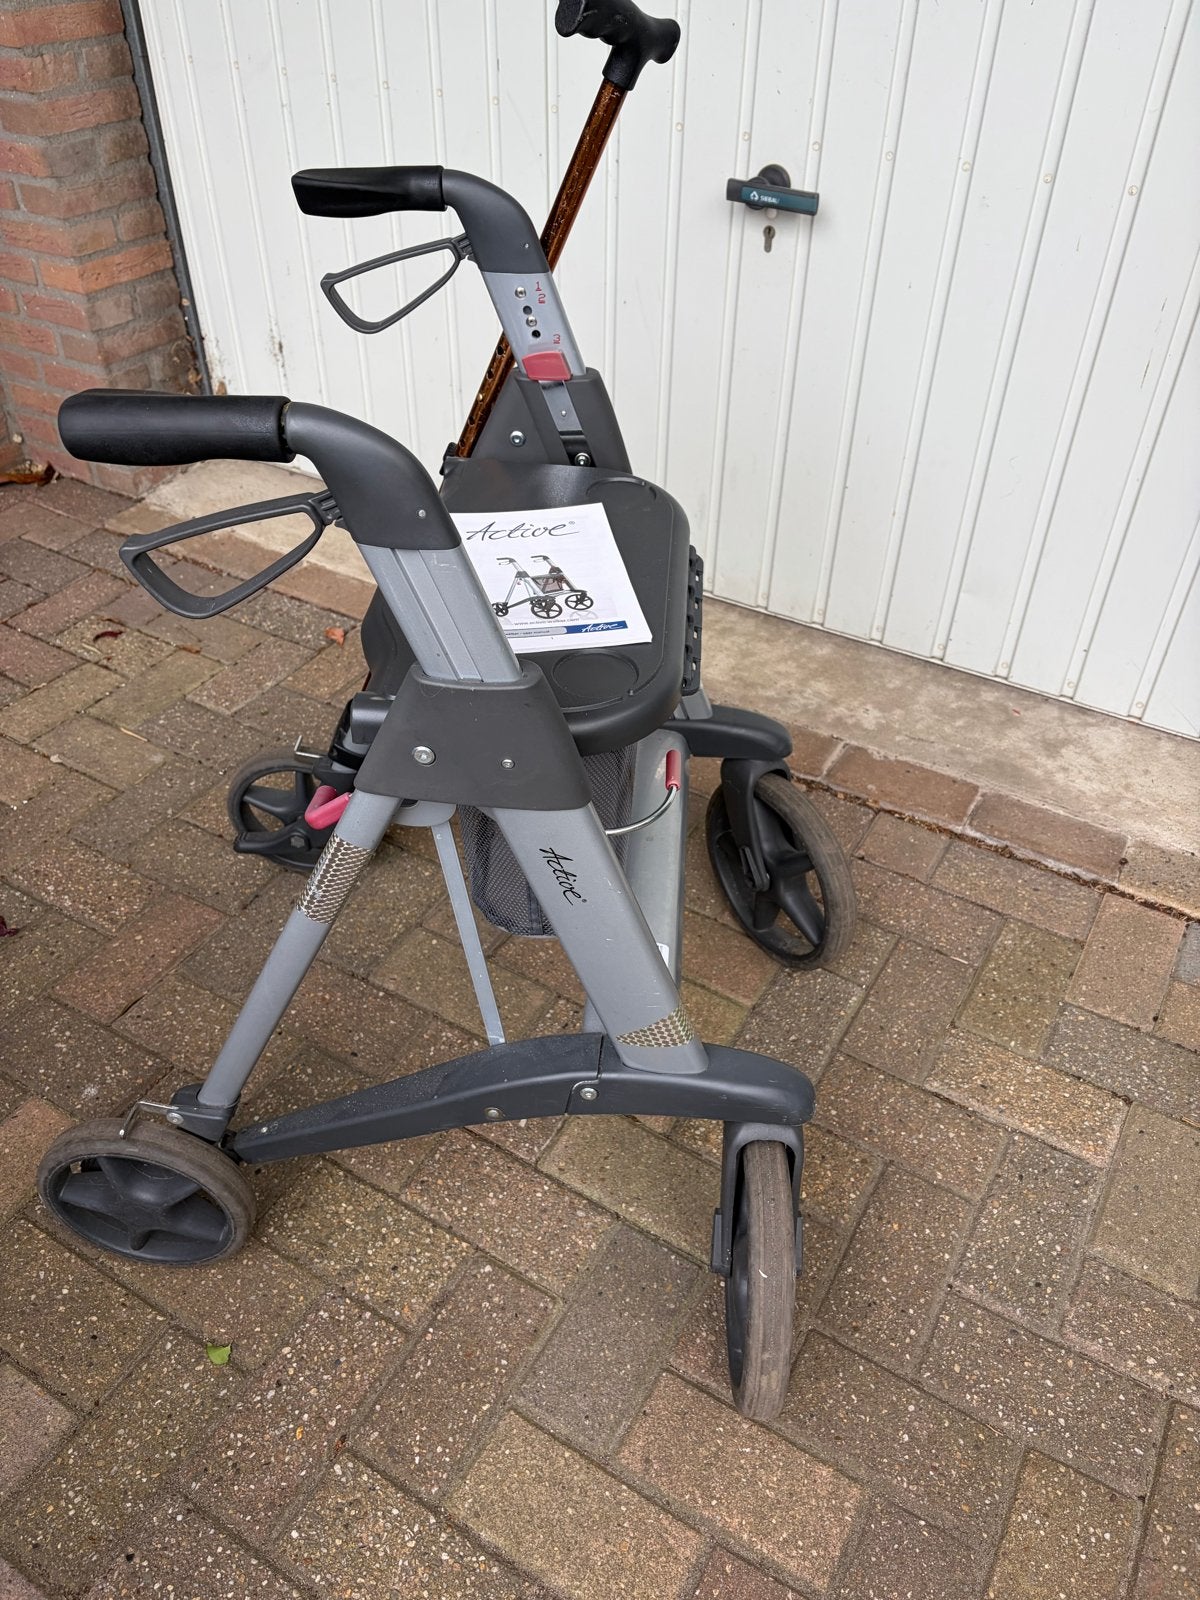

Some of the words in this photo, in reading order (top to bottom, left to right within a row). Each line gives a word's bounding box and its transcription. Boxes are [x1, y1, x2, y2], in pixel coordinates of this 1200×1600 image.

[535, 281, 542, 291] 1
[538, 293, 546, 304] 2
[553, 334, 561, 344] 3
